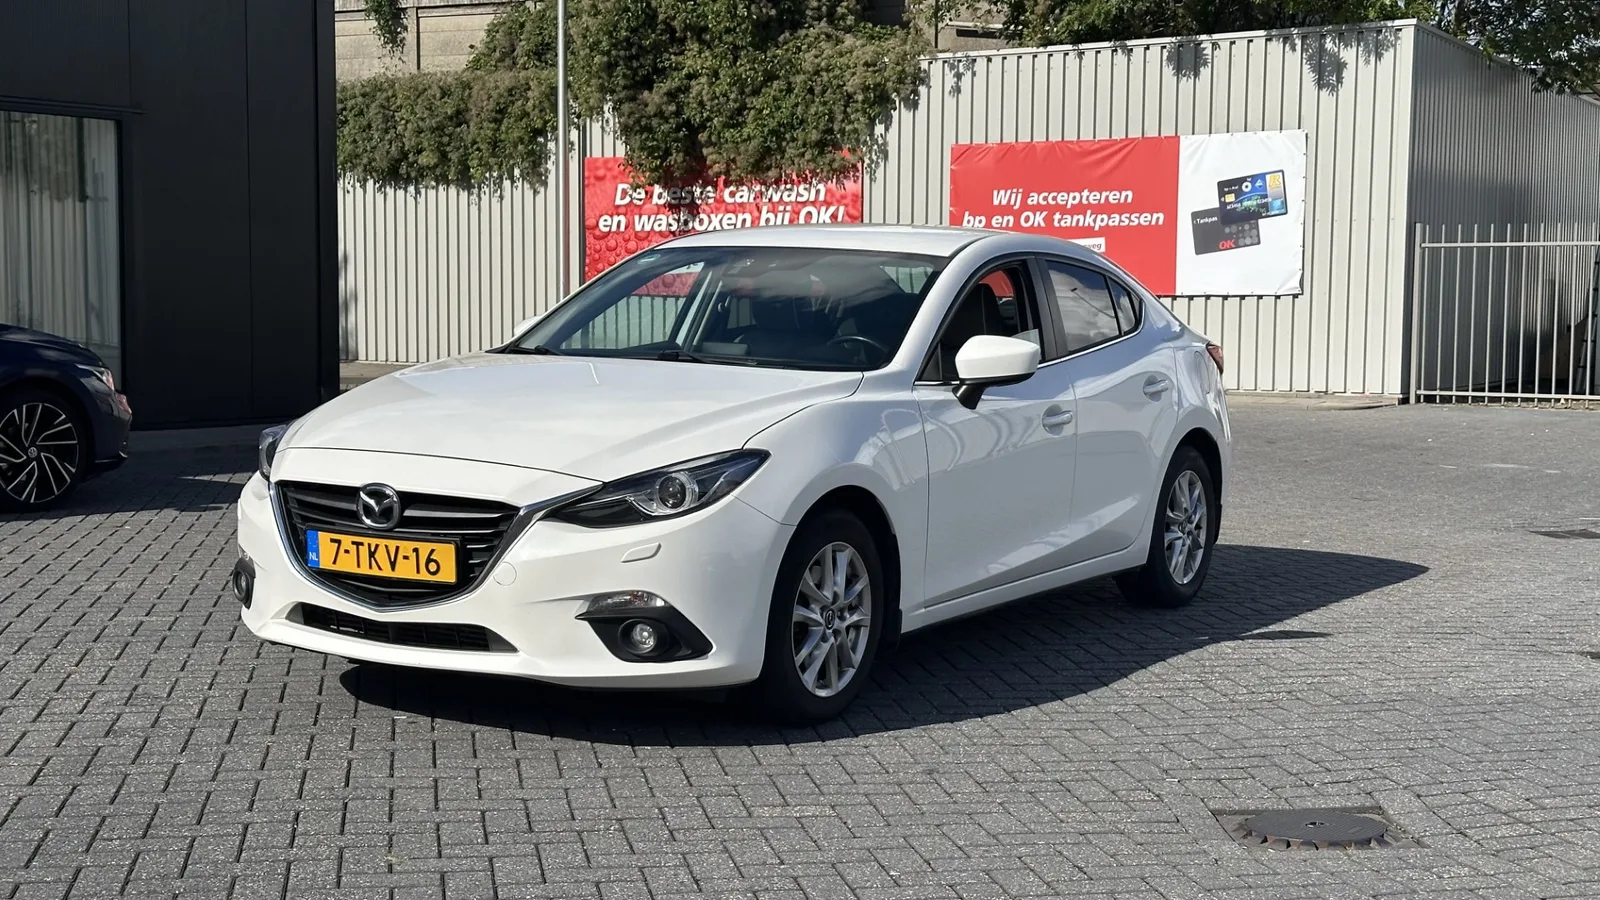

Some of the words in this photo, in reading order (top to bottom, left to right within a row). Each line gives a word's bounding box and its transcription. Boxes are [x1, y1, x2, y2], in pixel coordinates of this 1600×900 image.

[615, 183, 646, 206] De
[652, 182, 716, 205] beste
[723, 180, 826, 203] carwash
[992, 188, 1023, 209] Wij
[1027, 189, 1133, 209] accepteren
[598, 214, 626, 232] en
[634, 207, 752, 232] wasboxen
[799, 205, 845, 224] OK!
[962, 211, 986, 228] bp
[991, 215, 1014, 228] en
[1020, 211, 1048, 227] OK
[1053, 211, 1165, 230] tankpassen
[1196, 216, 1218, 225] Tankpas
[1219, 239, 1236, 249] OK
[309, 552, 318, 561] NL
[329, 537, 441, 576] 7-TKV-16
